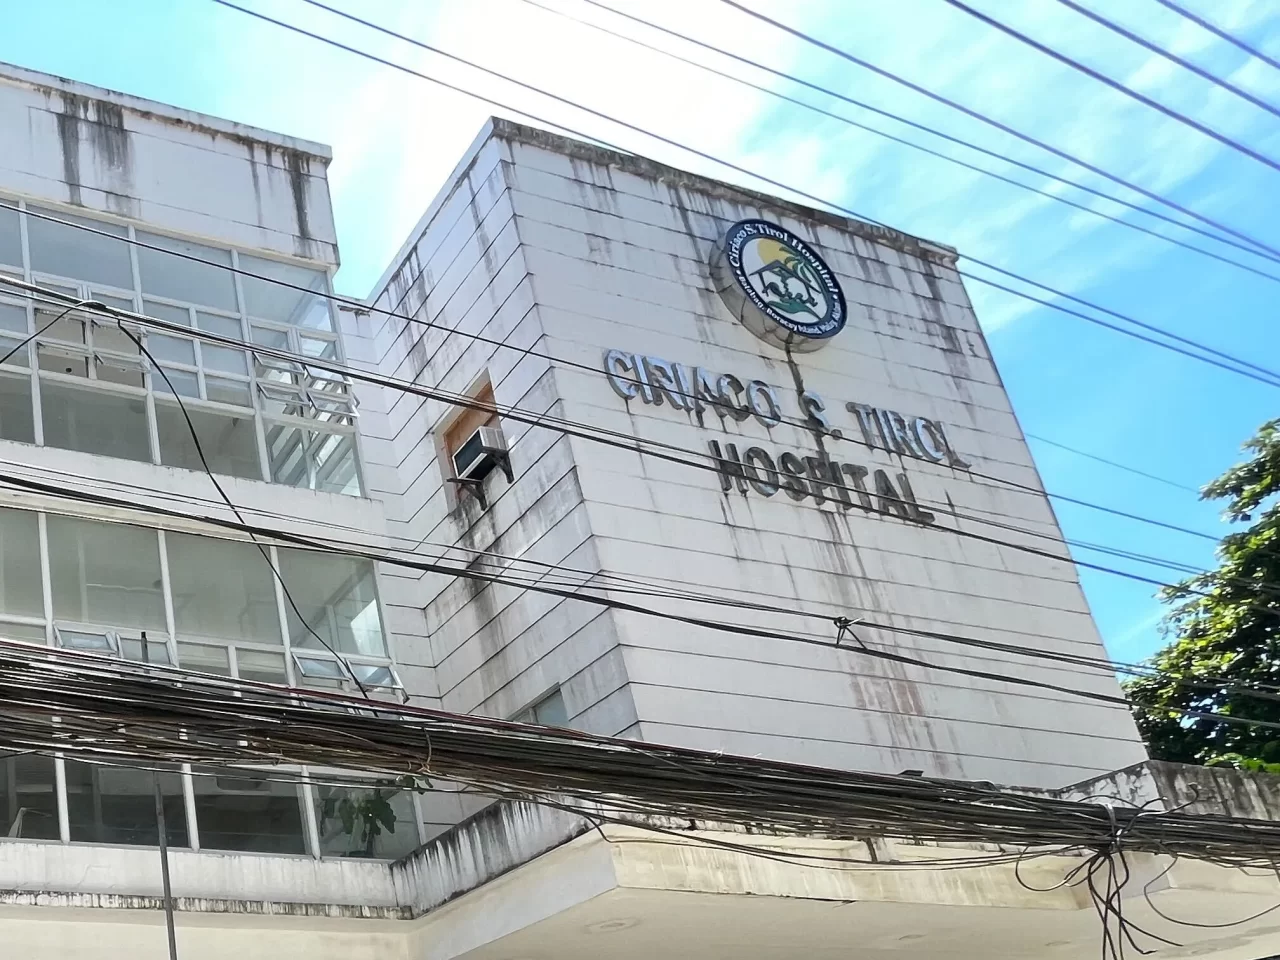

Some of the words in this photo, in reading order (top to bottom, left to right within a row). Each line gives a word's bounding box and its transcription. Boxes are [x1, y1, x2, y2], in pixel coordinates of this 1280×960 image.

[729, 230, 747, 267] Ciriaco
[755, 223, 788, 242] Tirol
[791, 239, 839, 293] Hospital
[604, 349, 782, 428] CIRIACO
[797, 389, 842, 441] S.
[845, 401, 972, 468] TIROL
[707, 439, 936, 524] HOSPITAL
